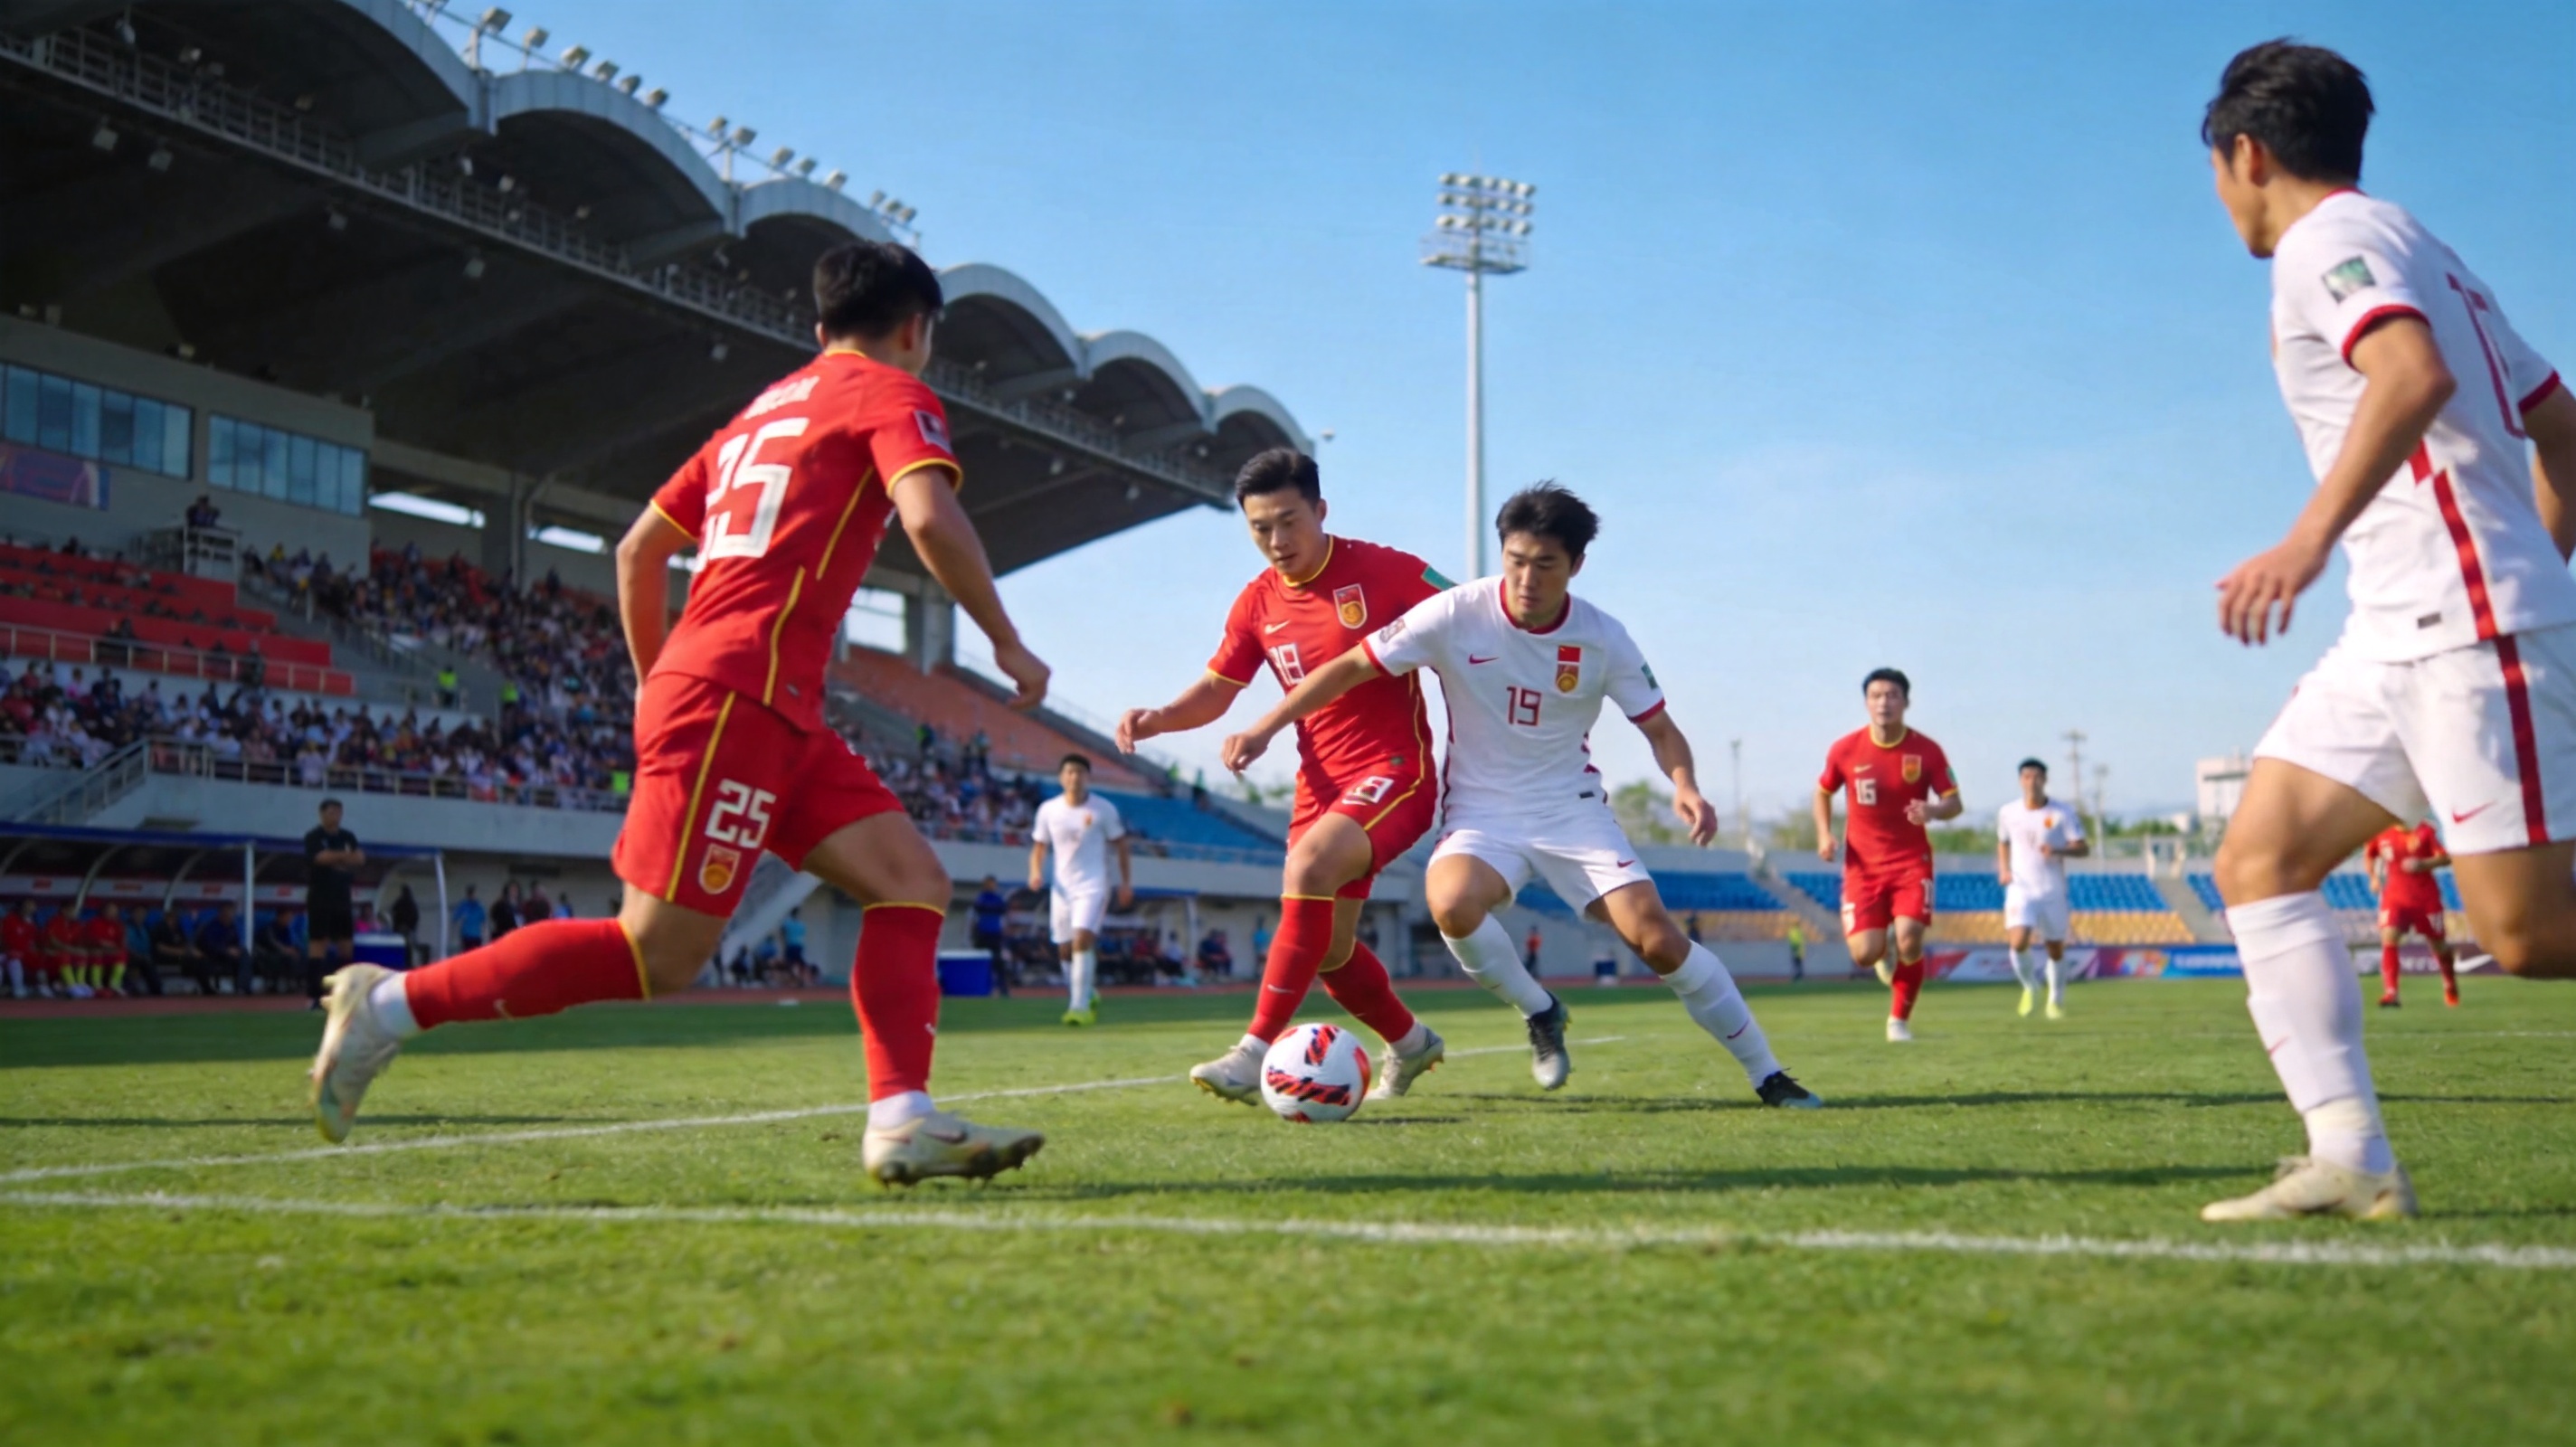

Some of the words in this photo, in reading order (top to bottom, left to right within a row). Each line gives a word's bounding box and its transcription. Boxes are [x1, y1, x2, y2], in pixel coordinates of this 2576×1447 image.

[1506, 686, 1542, 726] 19
[1855, 779, 1877, 806] 16
[705, 778, 777, 848] 25
